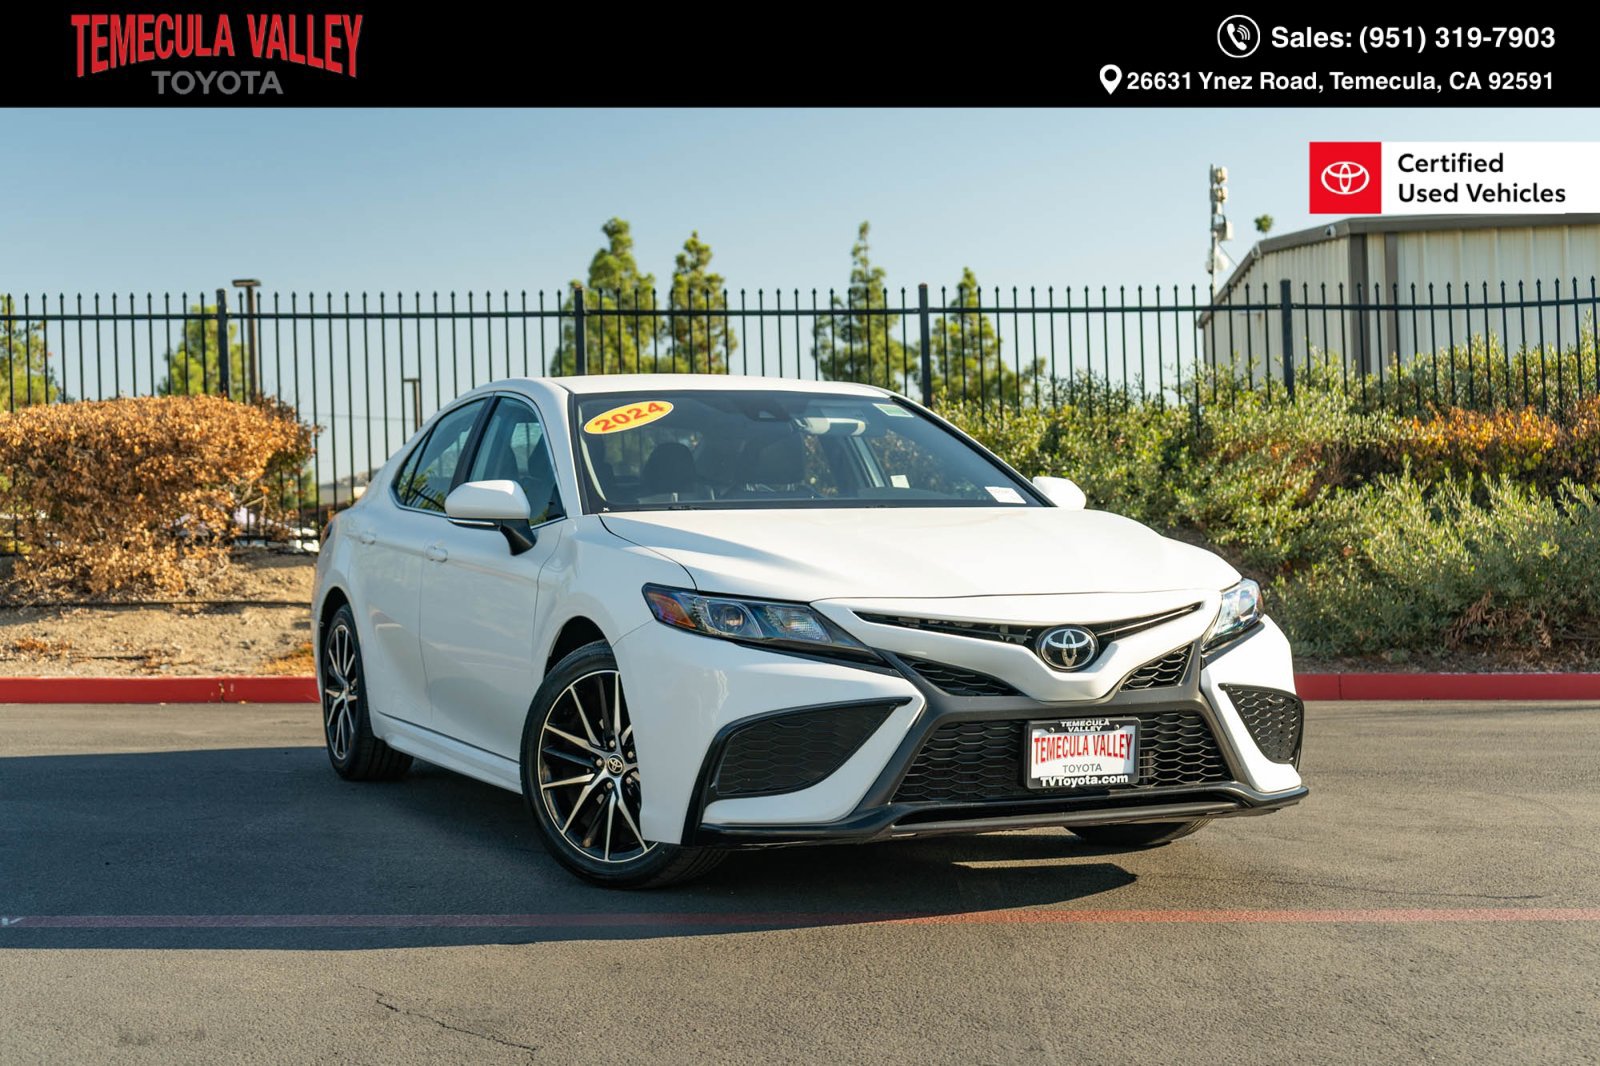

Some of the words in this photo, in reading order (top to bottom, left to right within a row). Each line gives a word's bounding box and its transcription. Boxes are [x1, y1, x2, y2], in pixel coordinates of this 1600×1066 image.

[594, 402, 664, 432] 2024
[1060, 719, 1110, 728] TEMECULA
[1033, 735, 1089, 765] TEMECULA
[1093, 733, 1133, 760] VALLEY
[1062, 763, 1102, 773] TOYOTA
[1040, 774, 1129, 788] TVToyota.com
